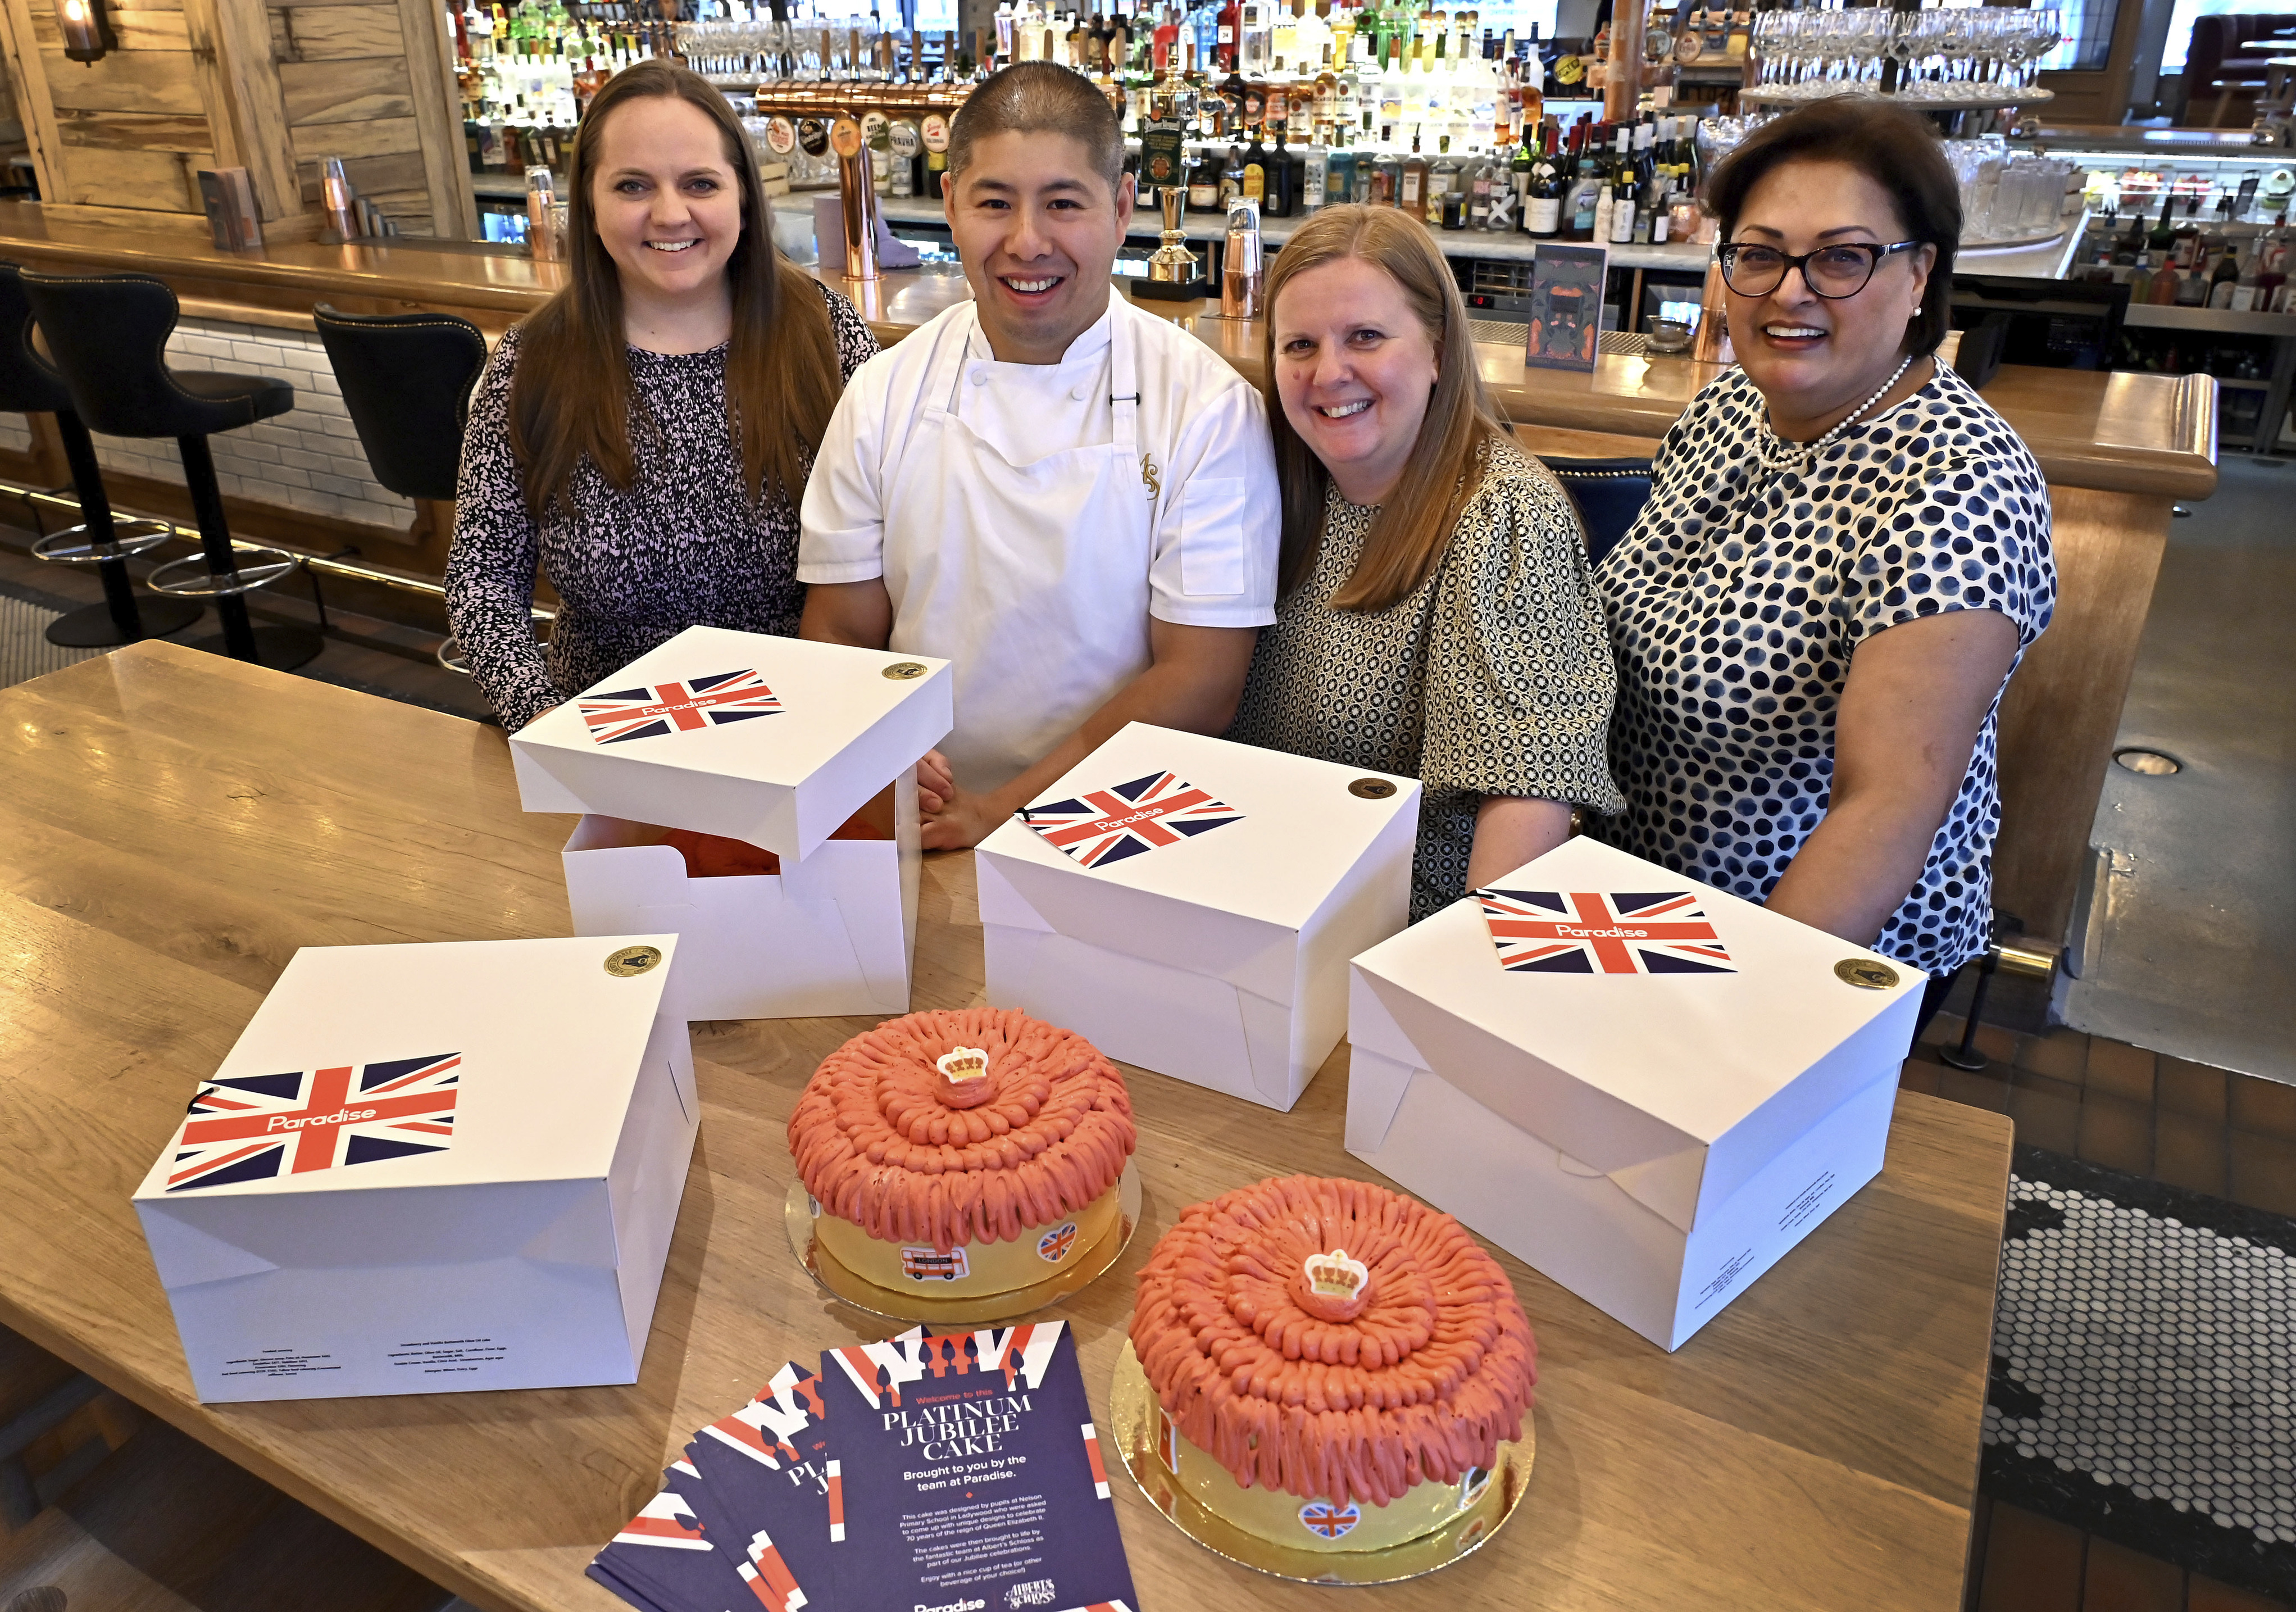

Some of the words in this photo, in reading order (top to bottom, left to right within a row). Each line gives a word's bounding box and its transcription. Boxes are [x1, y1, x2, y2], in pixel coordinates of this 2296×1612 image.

[642, 699, 717, 716] Paradise
[1094, 808, 1164, 831] Paradise
[1555, 924, 1648, 937] Paradise
[267, 1109, 376, 1132] Paradise
[916, 1393, 961, 1405] Welcome
[976, 1389, 993, 1397] this
[881, 1394, 1034, 1431] PLATINUM
[900, 1413, 1019, 1446] JUBILEE
[923, 1433, 1002, 1461] CAKE
[903, 1466, 949, 1481] Brought
[952, 1465, 964, 1474] to
[967, 1461, 988, 1474] you
[991, 1457, 1005, 1468] by
[1007, 1455, 1026, 1465] the
[917, 1479, 947, 1492] team
[949, 1477, 961, 1487] at
[963, 1469, 1017, 1484] Paradise.
[899, 1520, 925, 1528] Primary
[958, 1509, 992, 1519] Ladywood
[1027, 1500, 1047, 1508] asked
[949, 1504, 980, 1514] designed
[990, 1500, 1010, 1508] pupils
[956, 1518, 979, 1527] unique
[980, 1514, 1006, 1523] designs
[1015, 1507, 1046, 1517] celebrate
[916, 1533, 934, 1542] years
[956, 1525, 974, 1534] reign
[983, 1521, 1006, 1529] Queen
[1007, 1516, 1038, 1525] Elizabeth
[984, 1534, 1011, 1543] brought
[925, 1551, 954, 1560] fantastic
[982, 1542, 1008, 1551] Albert's
[1009, 1537, 1035, 1546] Schloss
[964, 1552, 988, 1561] Jubilee
[940, 1577, 973, 1587] beverage
[914, 1597, 985, 1612] Paradise
